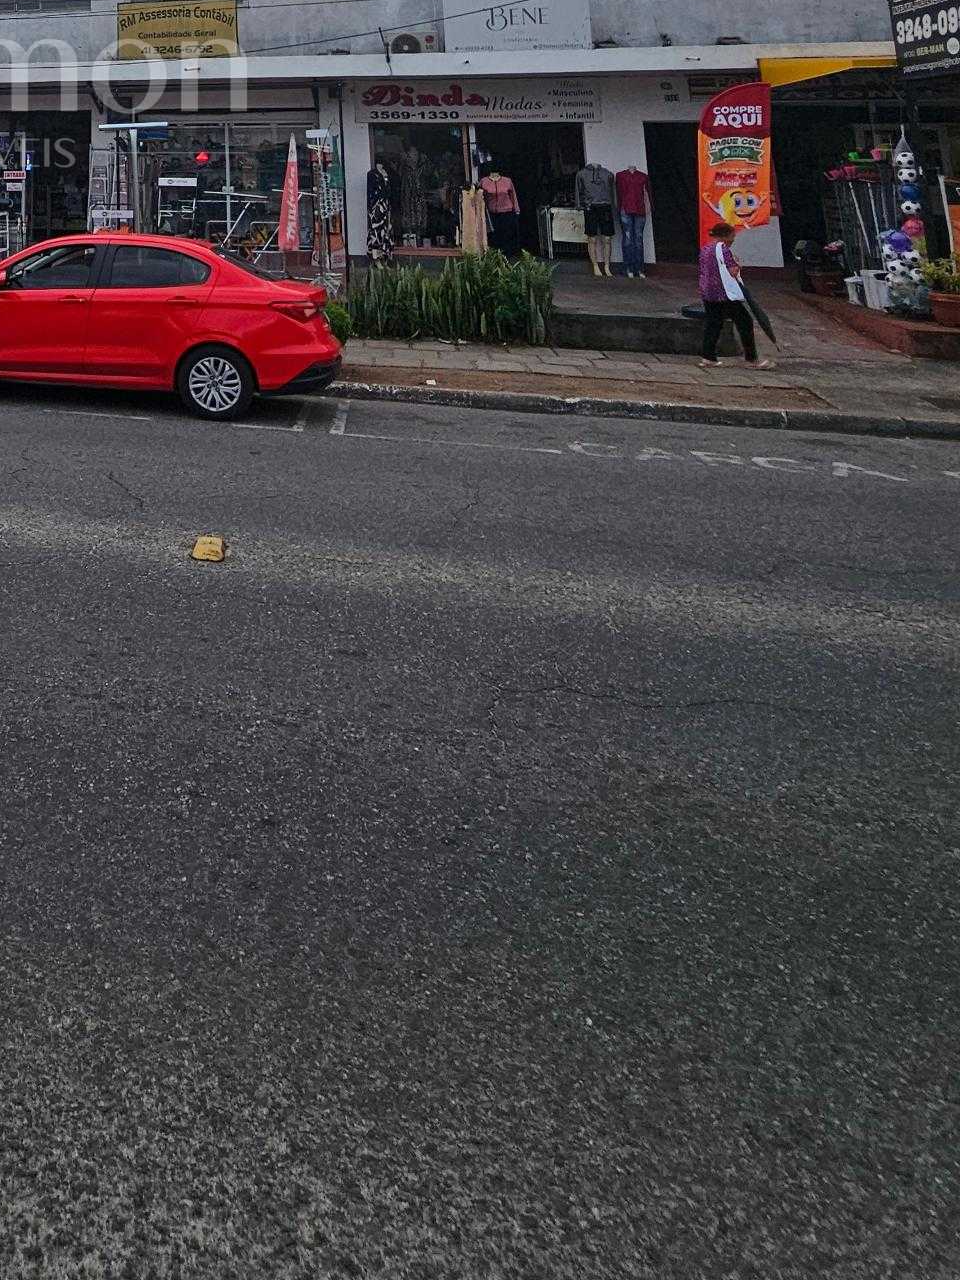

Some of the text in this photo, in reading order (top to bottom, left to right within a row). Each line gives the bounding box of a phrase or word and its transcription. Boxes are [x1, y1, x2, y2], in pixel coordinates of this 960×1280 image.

[120, 6, 235, 32] RM Assessoria Contábil
[486, 6, 551, 32] BENE
[896, 6, 960, 45] 3248-08
[138, 30, 217, 39] Contabilidade Geral
[360, 84, 486, 107] Dinda
[484, 96, 543, 111] Modas
[713, 106, 762, 114] COMPRE
[370, 110, 460, 120] 3569-1330
[713, 114, 763, 128] AQUI
